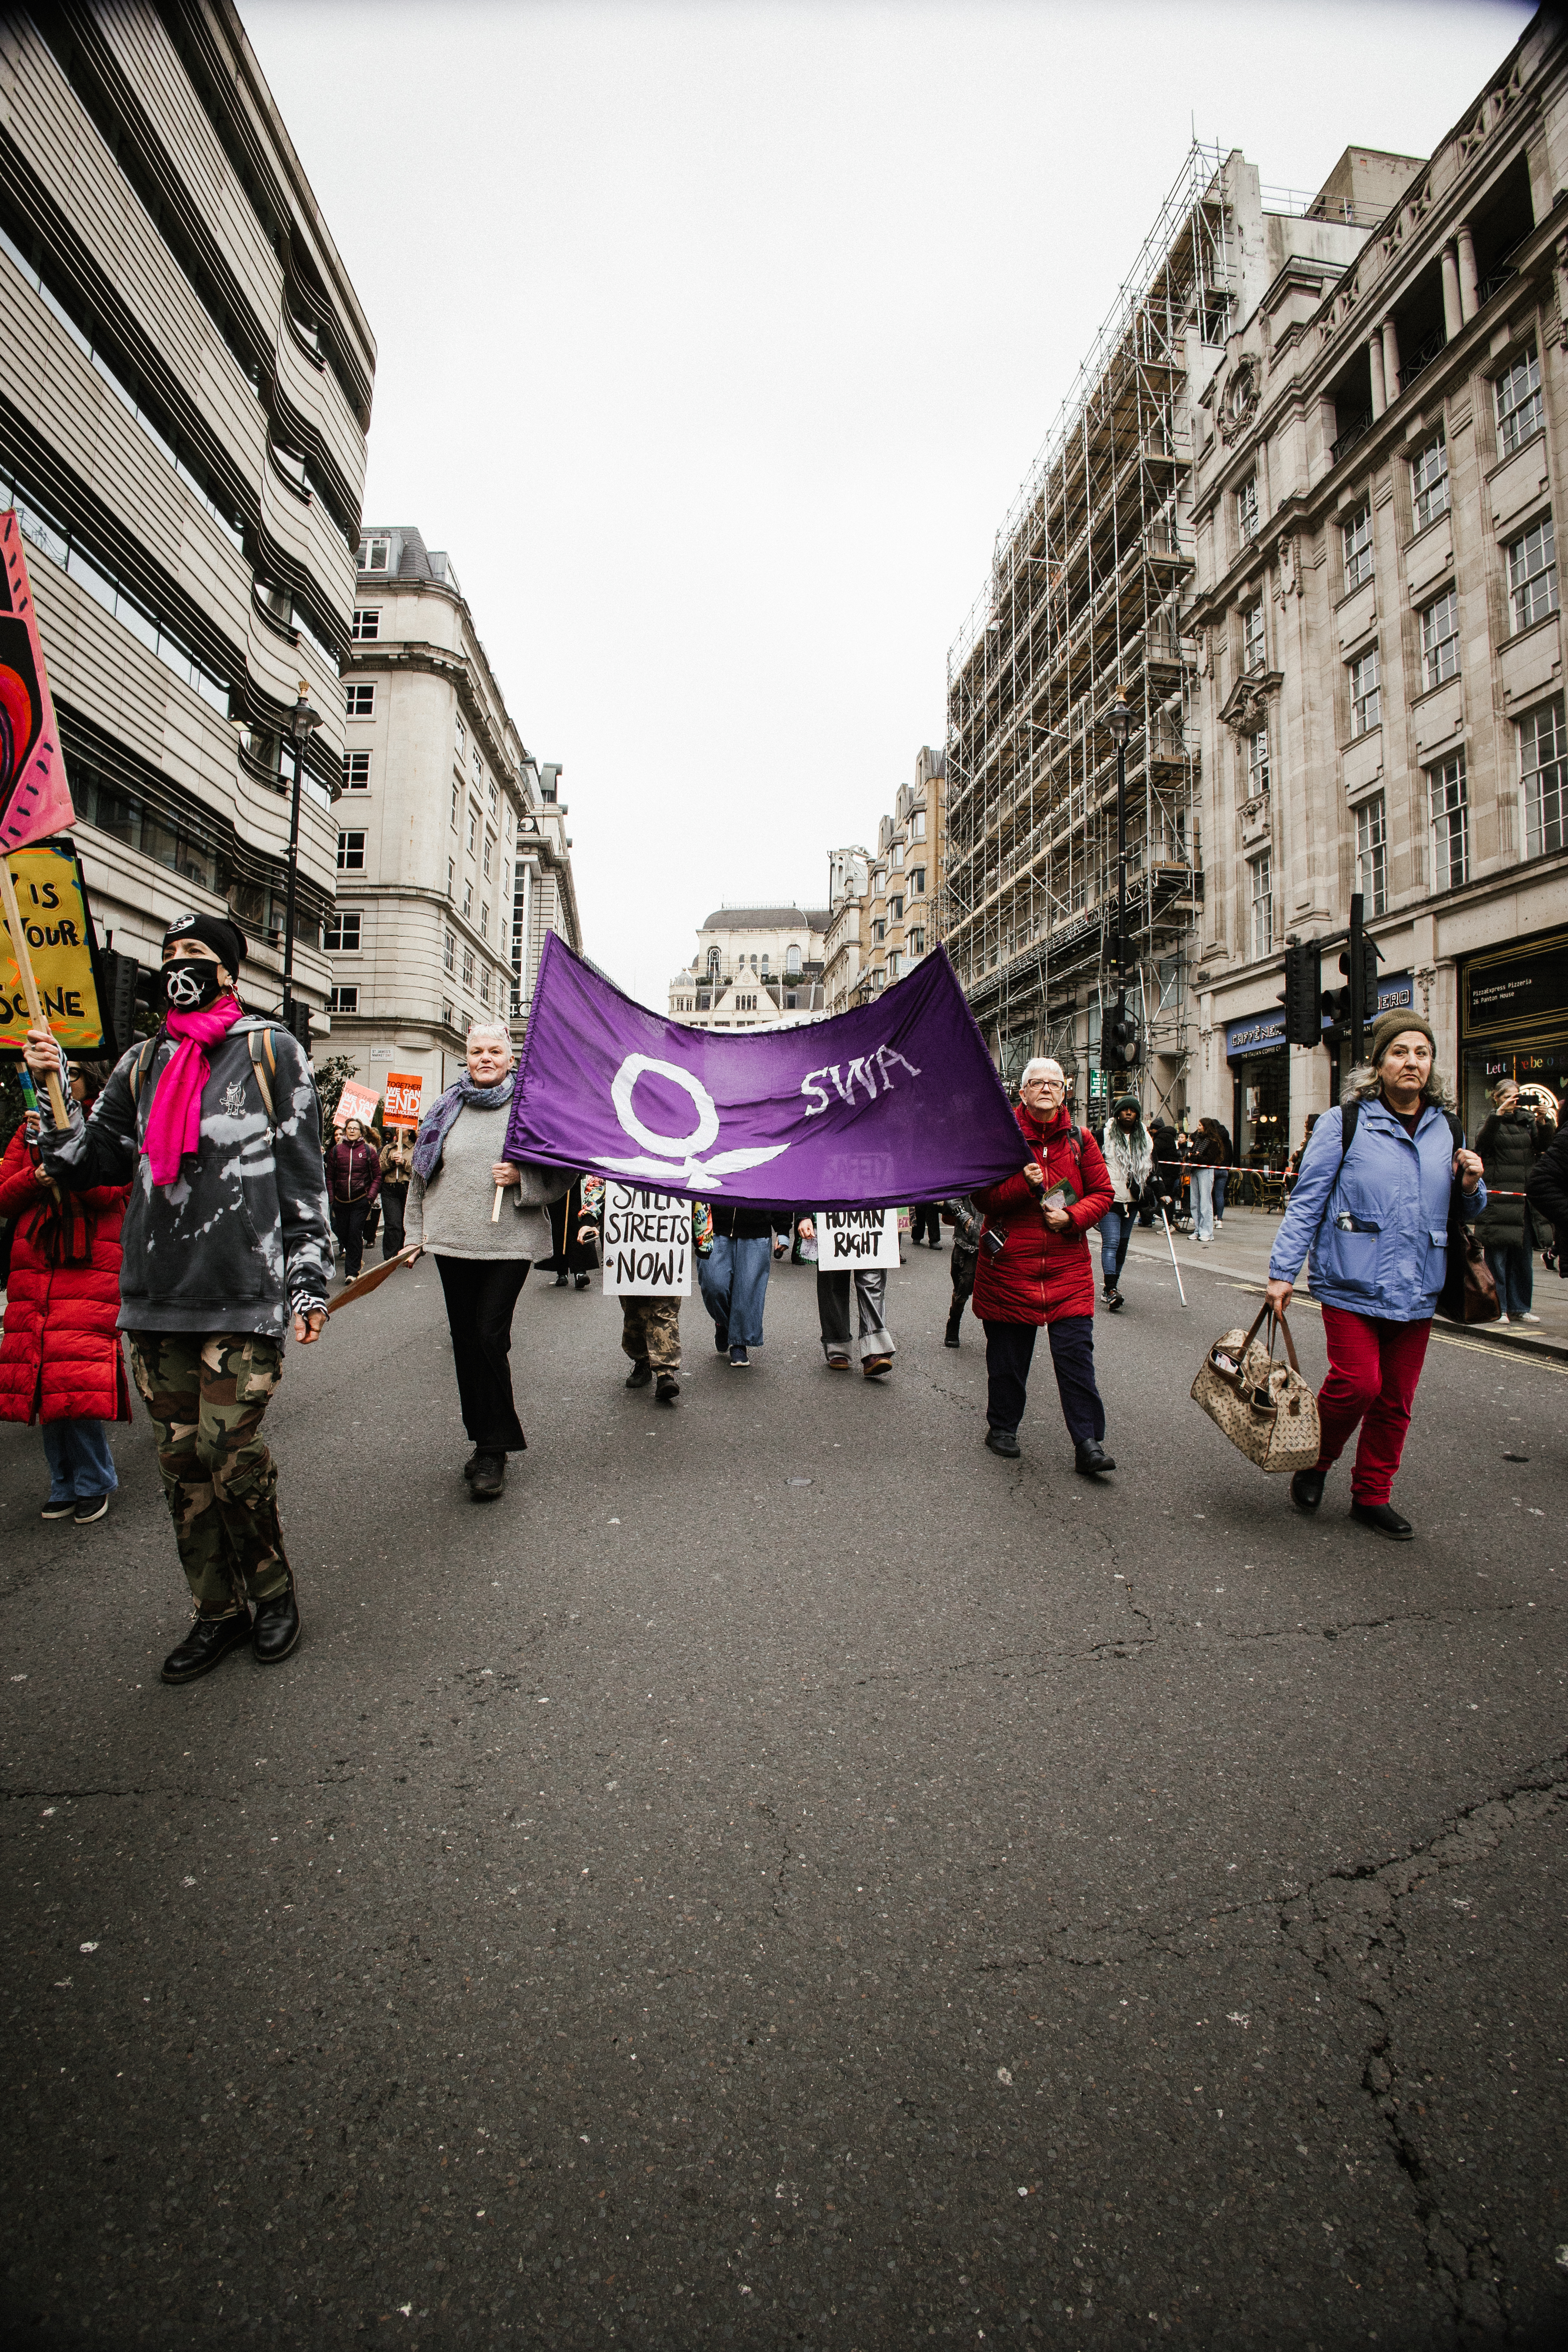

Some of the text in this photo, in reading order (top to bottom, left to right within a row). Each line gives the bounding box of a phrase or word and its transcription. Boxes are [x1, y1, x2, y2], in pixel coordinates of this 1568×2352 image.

[30, 883, 59, 909] IS
[1473, 978, 1532, 997] PizzaExpress Pizzeria
[1231, 1025, 1260, 1046] CAFFÈ
[1262, 1046, 1275, 1054] COFFEE
[1486, 1063, 1501, 1075] Let
[1530, 1056, 1543, 1068] be
[387, 1081, 421, 1090] TOGETHER
[801, 1044, 922, 1116] SWA
[344, 1092, 377, 1111] WE CAN
[345, 1087, 378, 1105] TOGETHER
[387, 1086, 421, 1098] WE CAN
[339, 1097, 373, 1120] END
[385, 1093, 420, 1112] END
[337, 1109, 350, 1118] MALE
[605, 1211, 690, 1245] STREETS
[825, 1209, 886, 1230] HUMAN
[834, 1231, 883, 1258] RIGHT
[617, 1248, 684, 1285] NOW!
